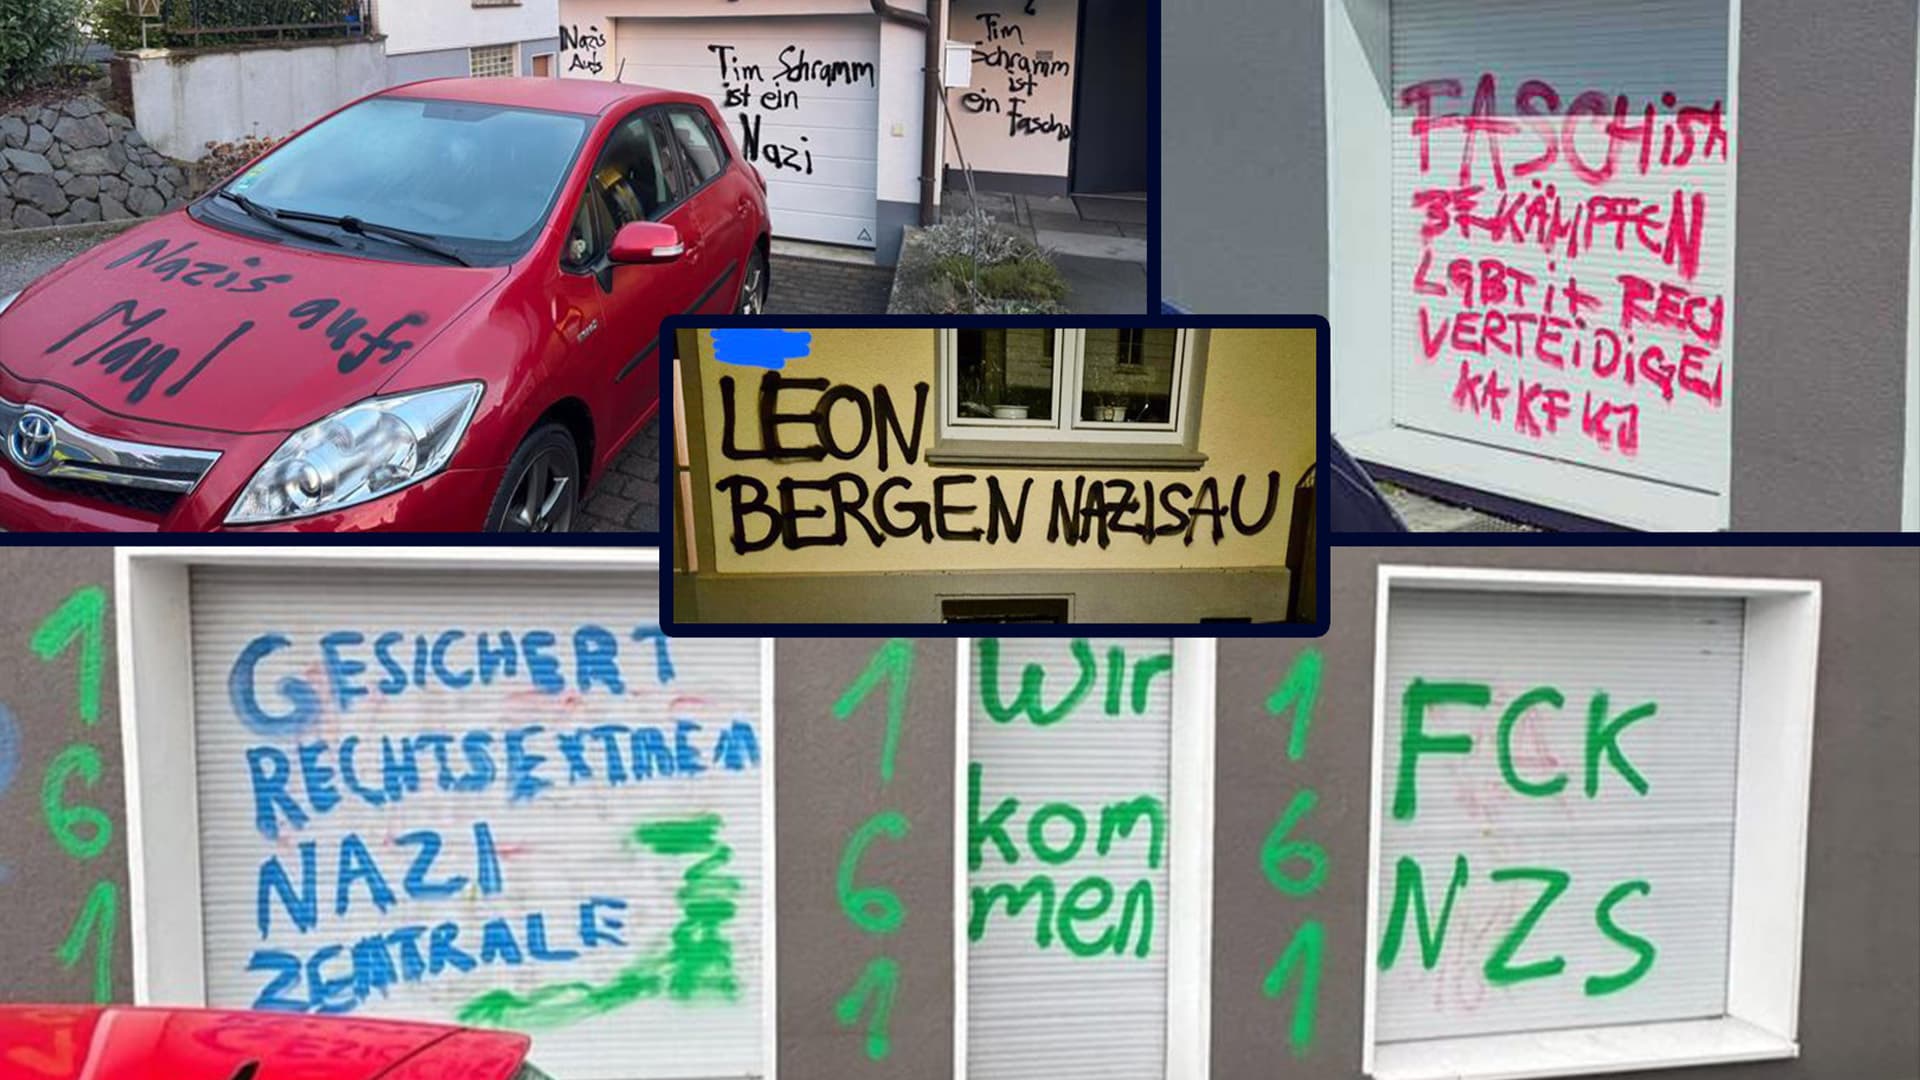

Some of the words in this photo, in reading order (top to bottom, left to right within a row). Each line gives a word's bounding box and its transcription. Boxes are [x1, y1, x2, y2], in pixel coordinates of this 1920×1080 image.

[707, 44, 764, 82] Tim
[773, 45, 875, 88] Schramm
[976, 13, 1024, 45] Tim
[723, 82, 750, 107] ist
[760, 81, 799, 110] ein
[1007, 69, 1038, 96] ist
[739, 113, 812, 175] Nazi
[104, 238, 293, 293] Nazis
[717, 369, 930, 471] LEON
[716, 472, 1035, 556] BERGEN
[1047, 469, 1281, 548] NAZISAU
[228, 624, 678, 734] GESICHERT
[976, 638, 1174, 727] Wir
[1392, 677, 1658, 821] FCK
[967, 761, 1166, 871] kom
[257, 821, 502, 940] NAZI
[967, 874, 1154, 958] men
[245, 896, 629, 1014] ZENTRALE
[1377, 854, 1657, 997] NZS
